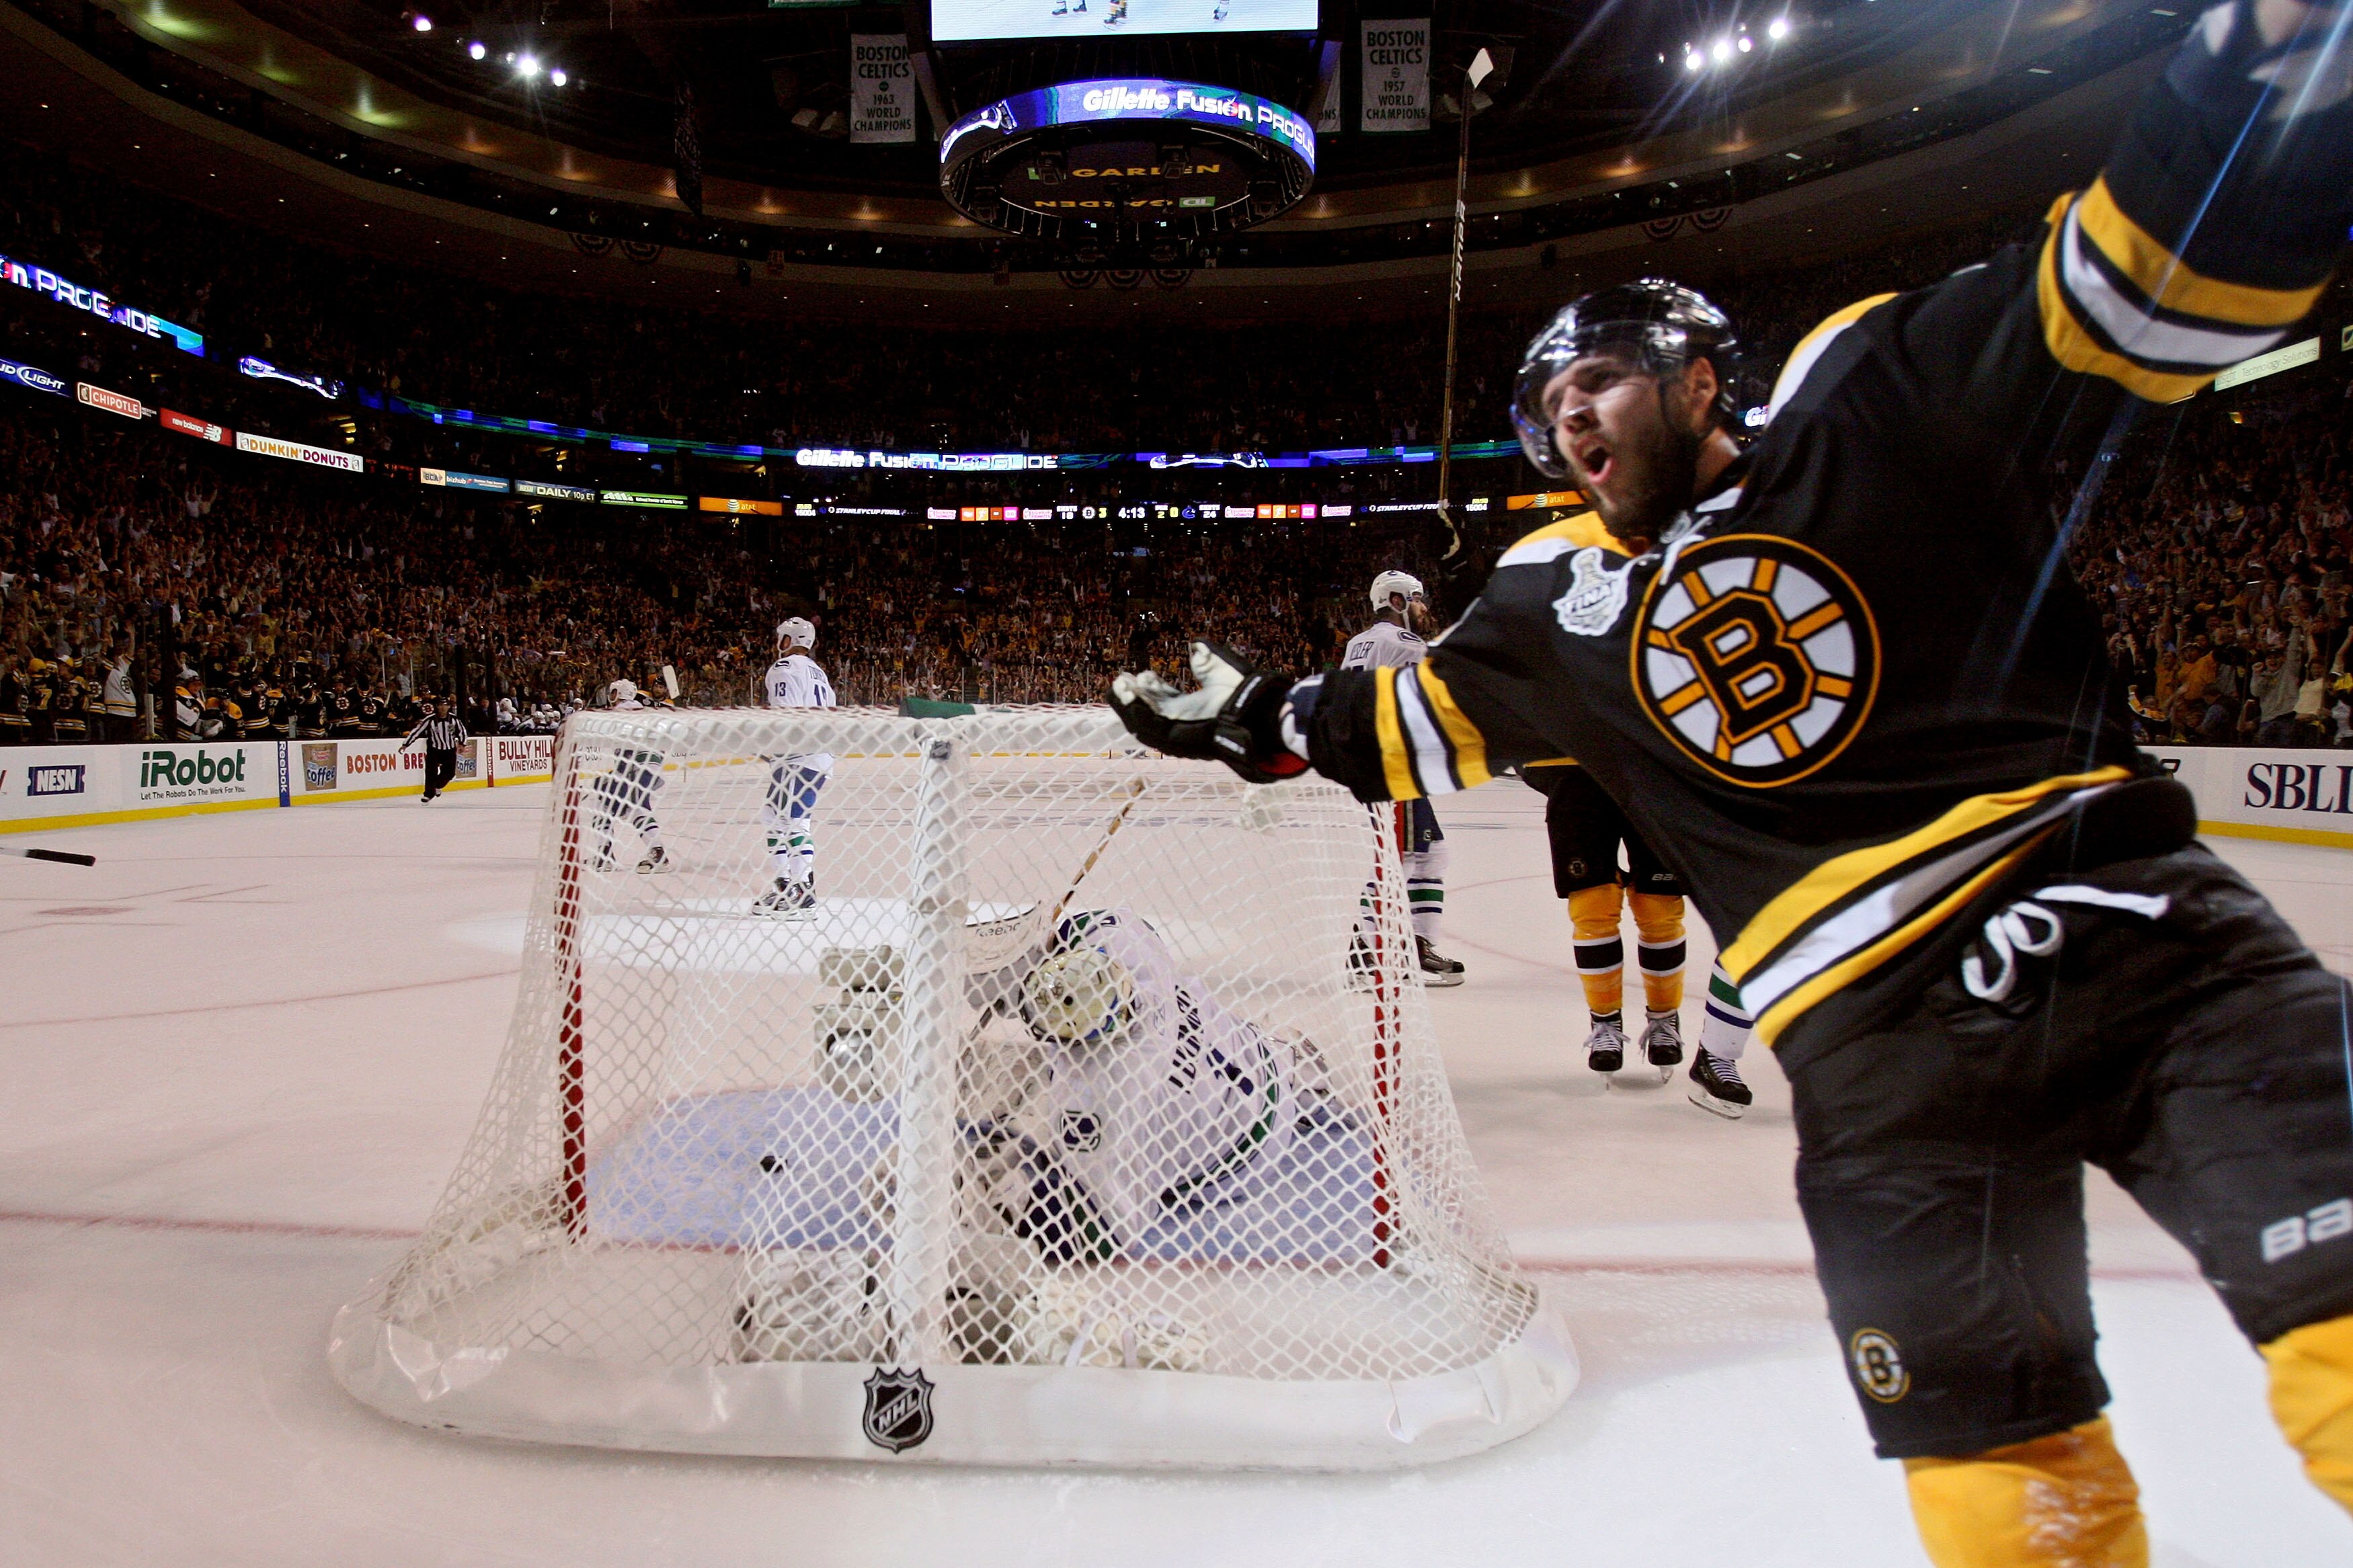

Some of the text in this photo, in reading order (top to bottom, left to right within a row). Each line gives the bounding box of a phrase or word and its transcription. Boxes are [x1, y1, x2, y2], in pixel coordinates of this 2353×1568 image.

[1367, 30, 1425, 46] BOSTON
[856, 46, 910, 61] BOSTON
[1369, 48, 1423, 65] CELTICS
[859, 62, 910, 79] CELTICS
[1384, 81, 1406, 92] 1957
[874, 94, 895, 105] 1963
[1083, 87, 1170, 112] Gillette
[1378, 95, 1414, 106] WORLD
[866, 108, 901, 118] WORLD
[1366, 108, 1426, 120] CHAMPIONS
[854, 119, 912, 131] CHAMPIONS
[2241, 359, 2281, 378] Technology
[2282, 347, 2318, 365] Solutions
[24, 370, 65, 390] LIGHT
[93, 392, 139, 415] CHIPOTLE
[172, 418, 183, 426] new
[184, 420, 204, 433] balance
[250, 439, 302, 459] DUNKIN'
[303, 450, 349, 468] DONUTS
[796, 449, 865, 468] Gillette
[446, 476, 467, 485] bizhub
[537, 487, 571, 498] DAILY
[573, 491, 585, 500] 10p
[1550, 495, 1564, 503] at&t
[1099, 507, 1107, 518] 3
[1118, 507, 1146, 519] 4:13
[1170, 507, 1179, 518] 0
[1667, 587, 1815, 747] B
[774, 682, 786, 697] 13
[499, 741, 532, 761] BULLY
[141, 749, 246, 788] iRobot
[278, 741, 288, 793] Reebok
[347, 753, 397, 774] BOSTON
[510, 759, 547, 772] VINEYARDS
[36, 769, 77, 792] NESN
[307, 768, 335, 786] coffee
[141, 792, 151, 800] Let
[153, 792, 165, 800] The
[166, 790, 187, 798] Robots
[188, 789, 196, 797] Do
[210, 787, 224, 795] Work
[2244, 763, 2353, 814] SBLI
[878, 1393, 918, 1433] NHL
